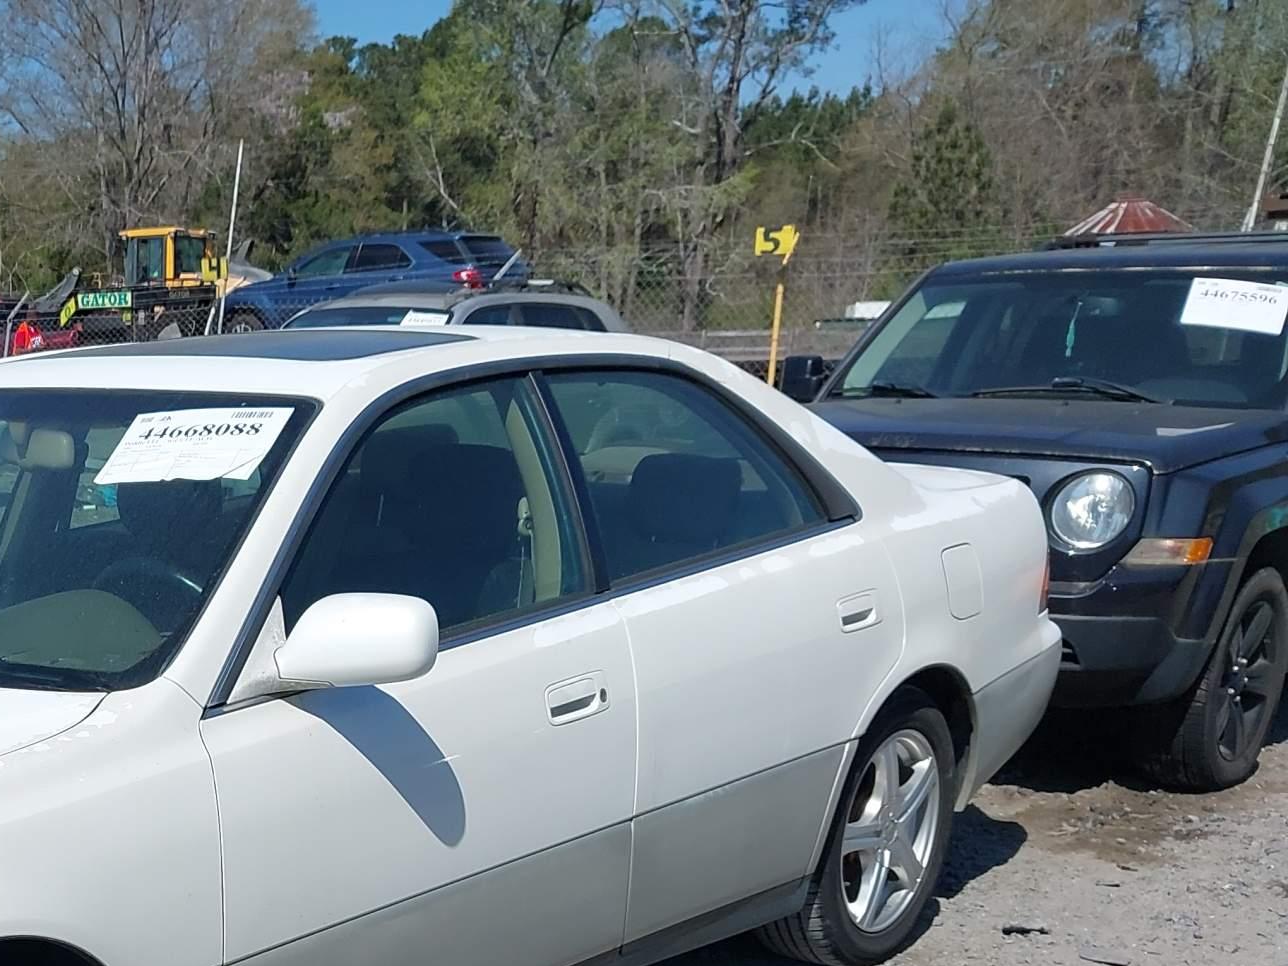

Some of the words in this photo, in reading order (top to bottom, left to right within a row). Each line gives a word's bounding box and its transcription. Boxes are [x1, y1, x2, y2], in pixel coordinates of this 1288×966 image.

[760, 226, 782, 254] 5
[208, 256, 221, 279] 4
[80, 291, 130, 307] GATOR
[138, 421, 265, 441] 44668088
